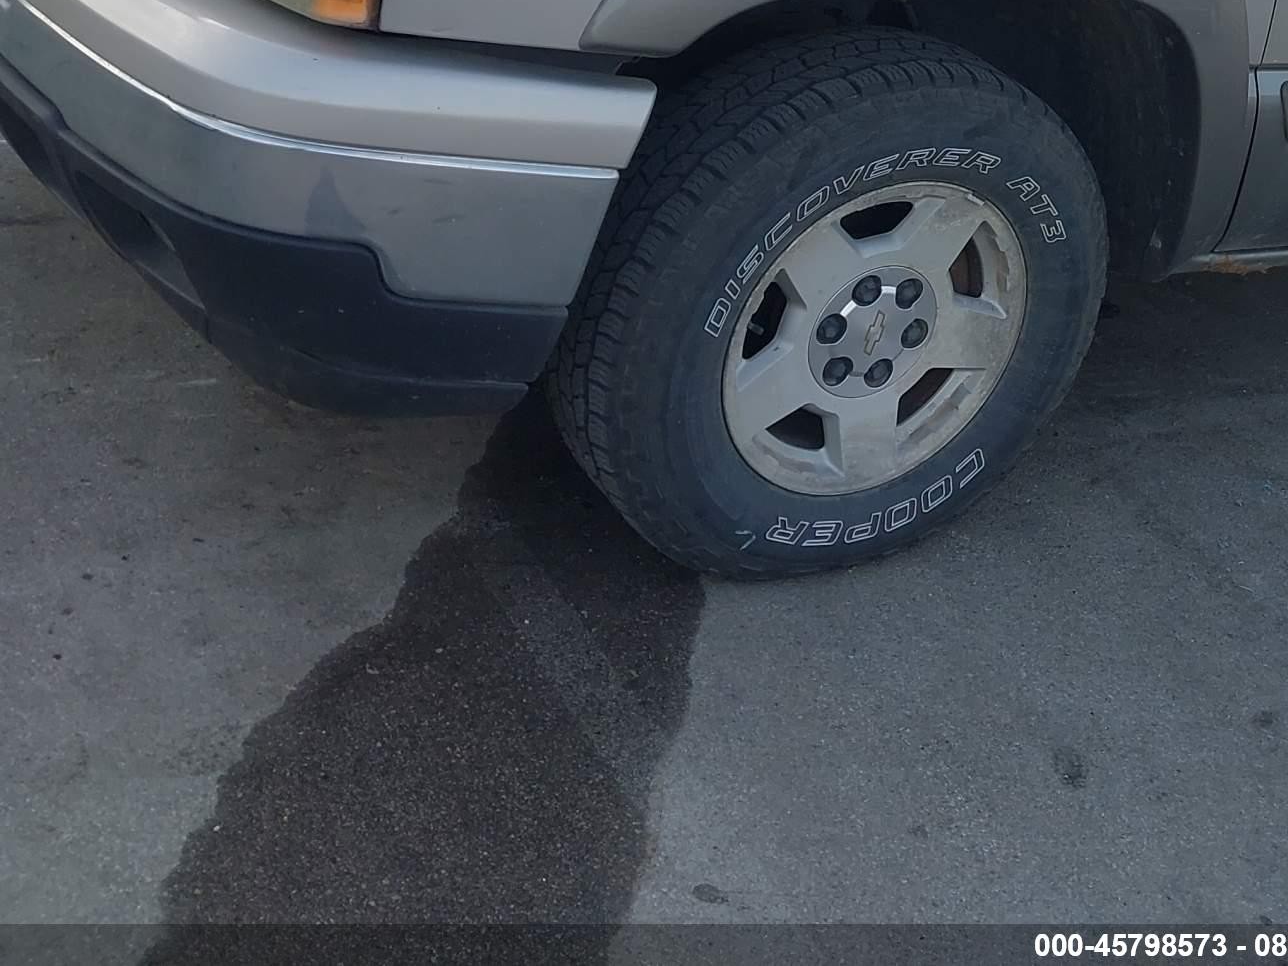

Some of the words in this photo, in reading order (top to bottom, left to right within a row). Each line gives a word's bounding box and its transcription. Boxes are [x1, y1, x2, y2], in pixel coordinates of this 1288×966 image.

[703, 146, 1002, 338] DISCOVERER
[1006, 175, 1067, 244] AT3
[765, 448, 986, 548] COOPER
